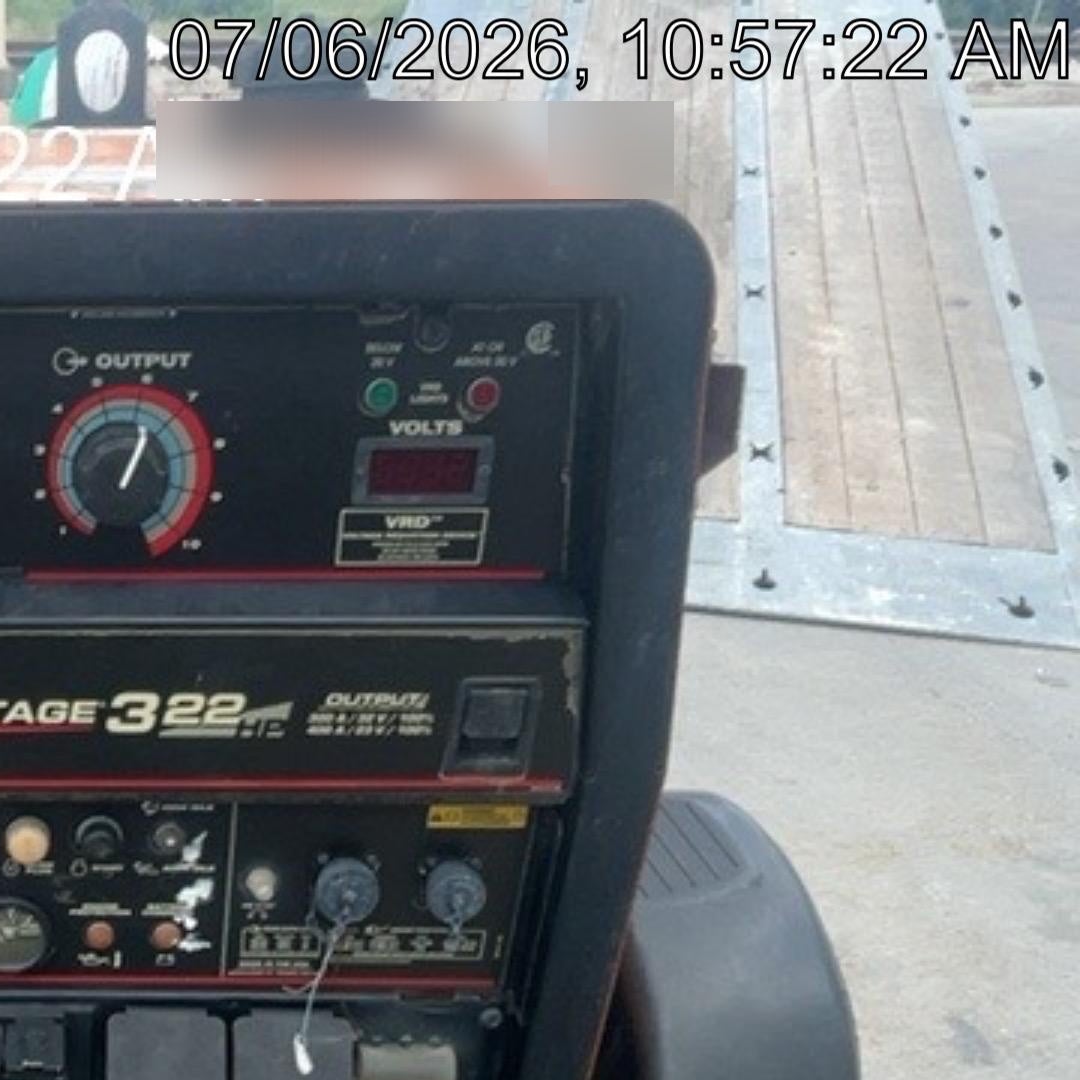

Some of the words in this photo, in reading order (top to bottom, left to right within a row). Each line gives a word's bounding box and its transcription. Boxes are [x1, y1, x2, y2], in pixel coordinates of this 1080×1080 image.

[95, 352, 192, 369] OUTPUT
[389, 419, 464, 436] VOLTS
[105, 691, 247, 735] 322
